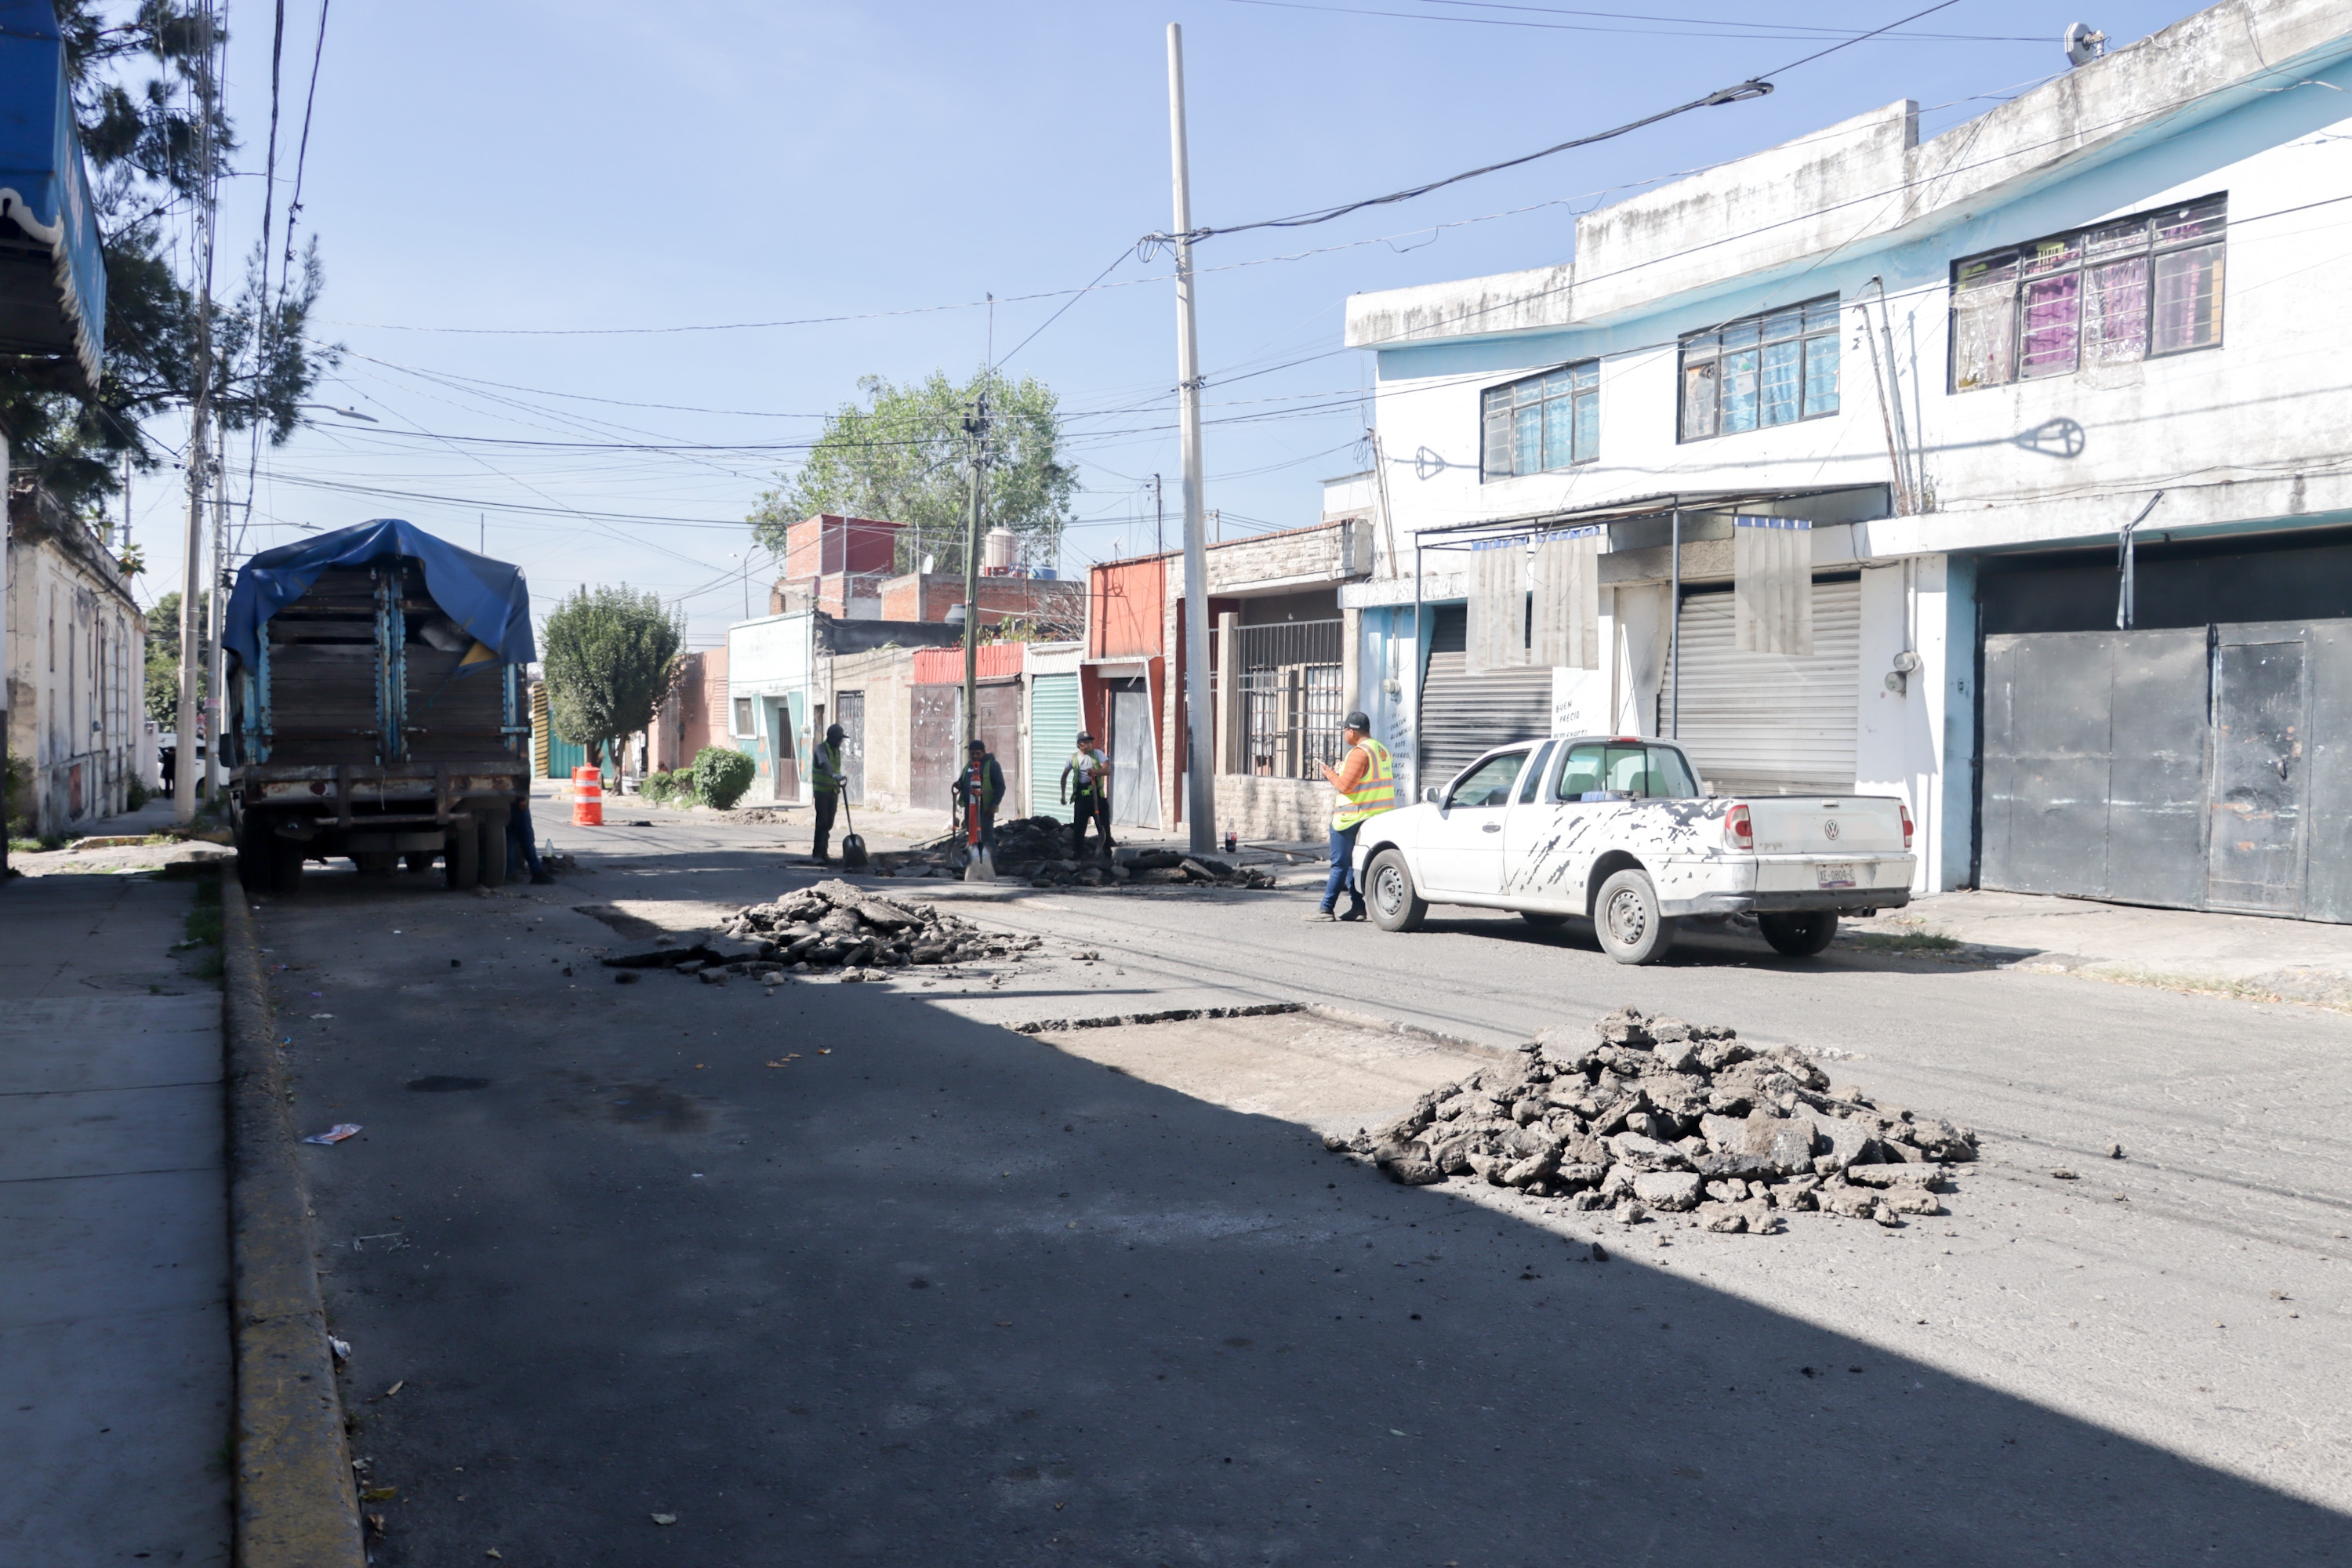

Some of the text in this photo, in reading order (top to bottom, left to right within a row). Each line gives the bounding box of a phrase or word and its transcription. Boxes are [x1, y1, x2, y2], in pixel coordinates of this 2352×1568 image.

[1556, 699, 1572, 713] BUEN
[1559, 710, 1579, 724] PRECIO
[1391, 725, 1412, 740] ALUMINIO
